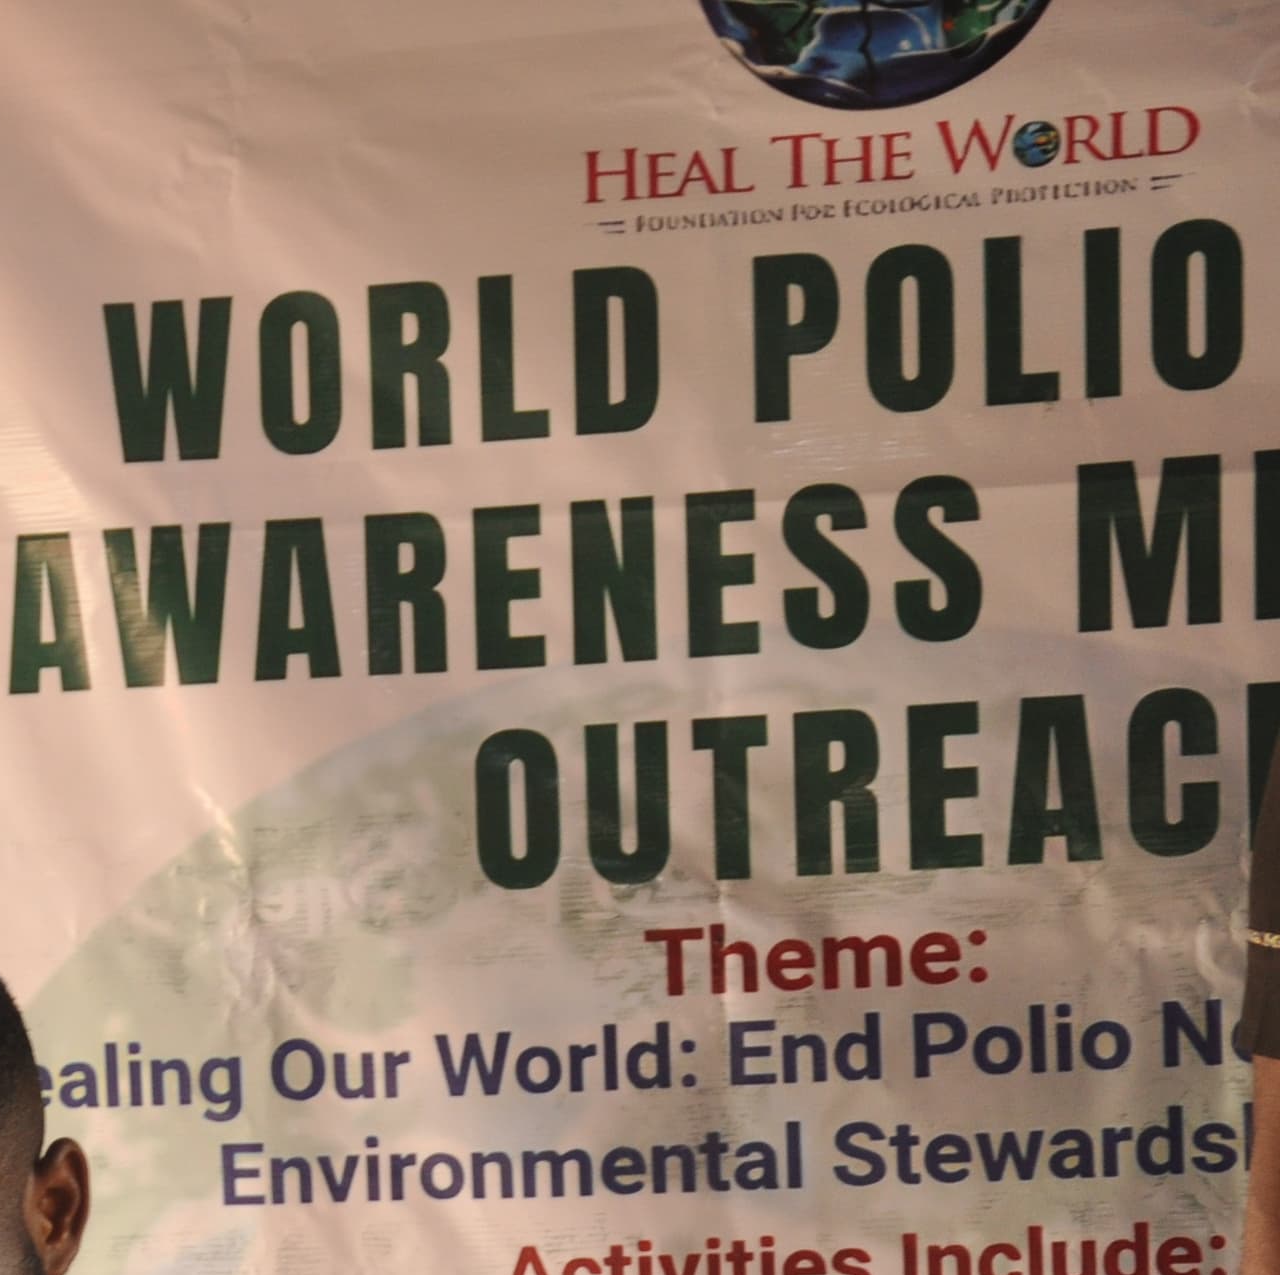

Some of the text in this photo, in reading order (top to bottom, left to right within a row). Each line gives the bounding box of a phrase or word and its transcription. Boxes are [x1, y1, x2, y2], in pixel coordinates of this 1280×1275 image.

[583, 148, 755, 203] HEAL
[771, 131, 915, 189] THE
[635, 177, 1140, 232] FOUNDATION FOR ECOLOGICAL PROTECTION
[102, 218, 1244, 463] WORLD POLIO
[8, 474, 984, 696] AWARENESS
[644, 924, 989, 998] Theme:
[270, 1036, 411, 1103] Our
[435, 1021, 698, 1098] World:
[727, 1013, 883, 1088] End
[912, 1002, 1132, 1080] Polio
[220, 1101, 1254, 1208] Environmental Stewards
